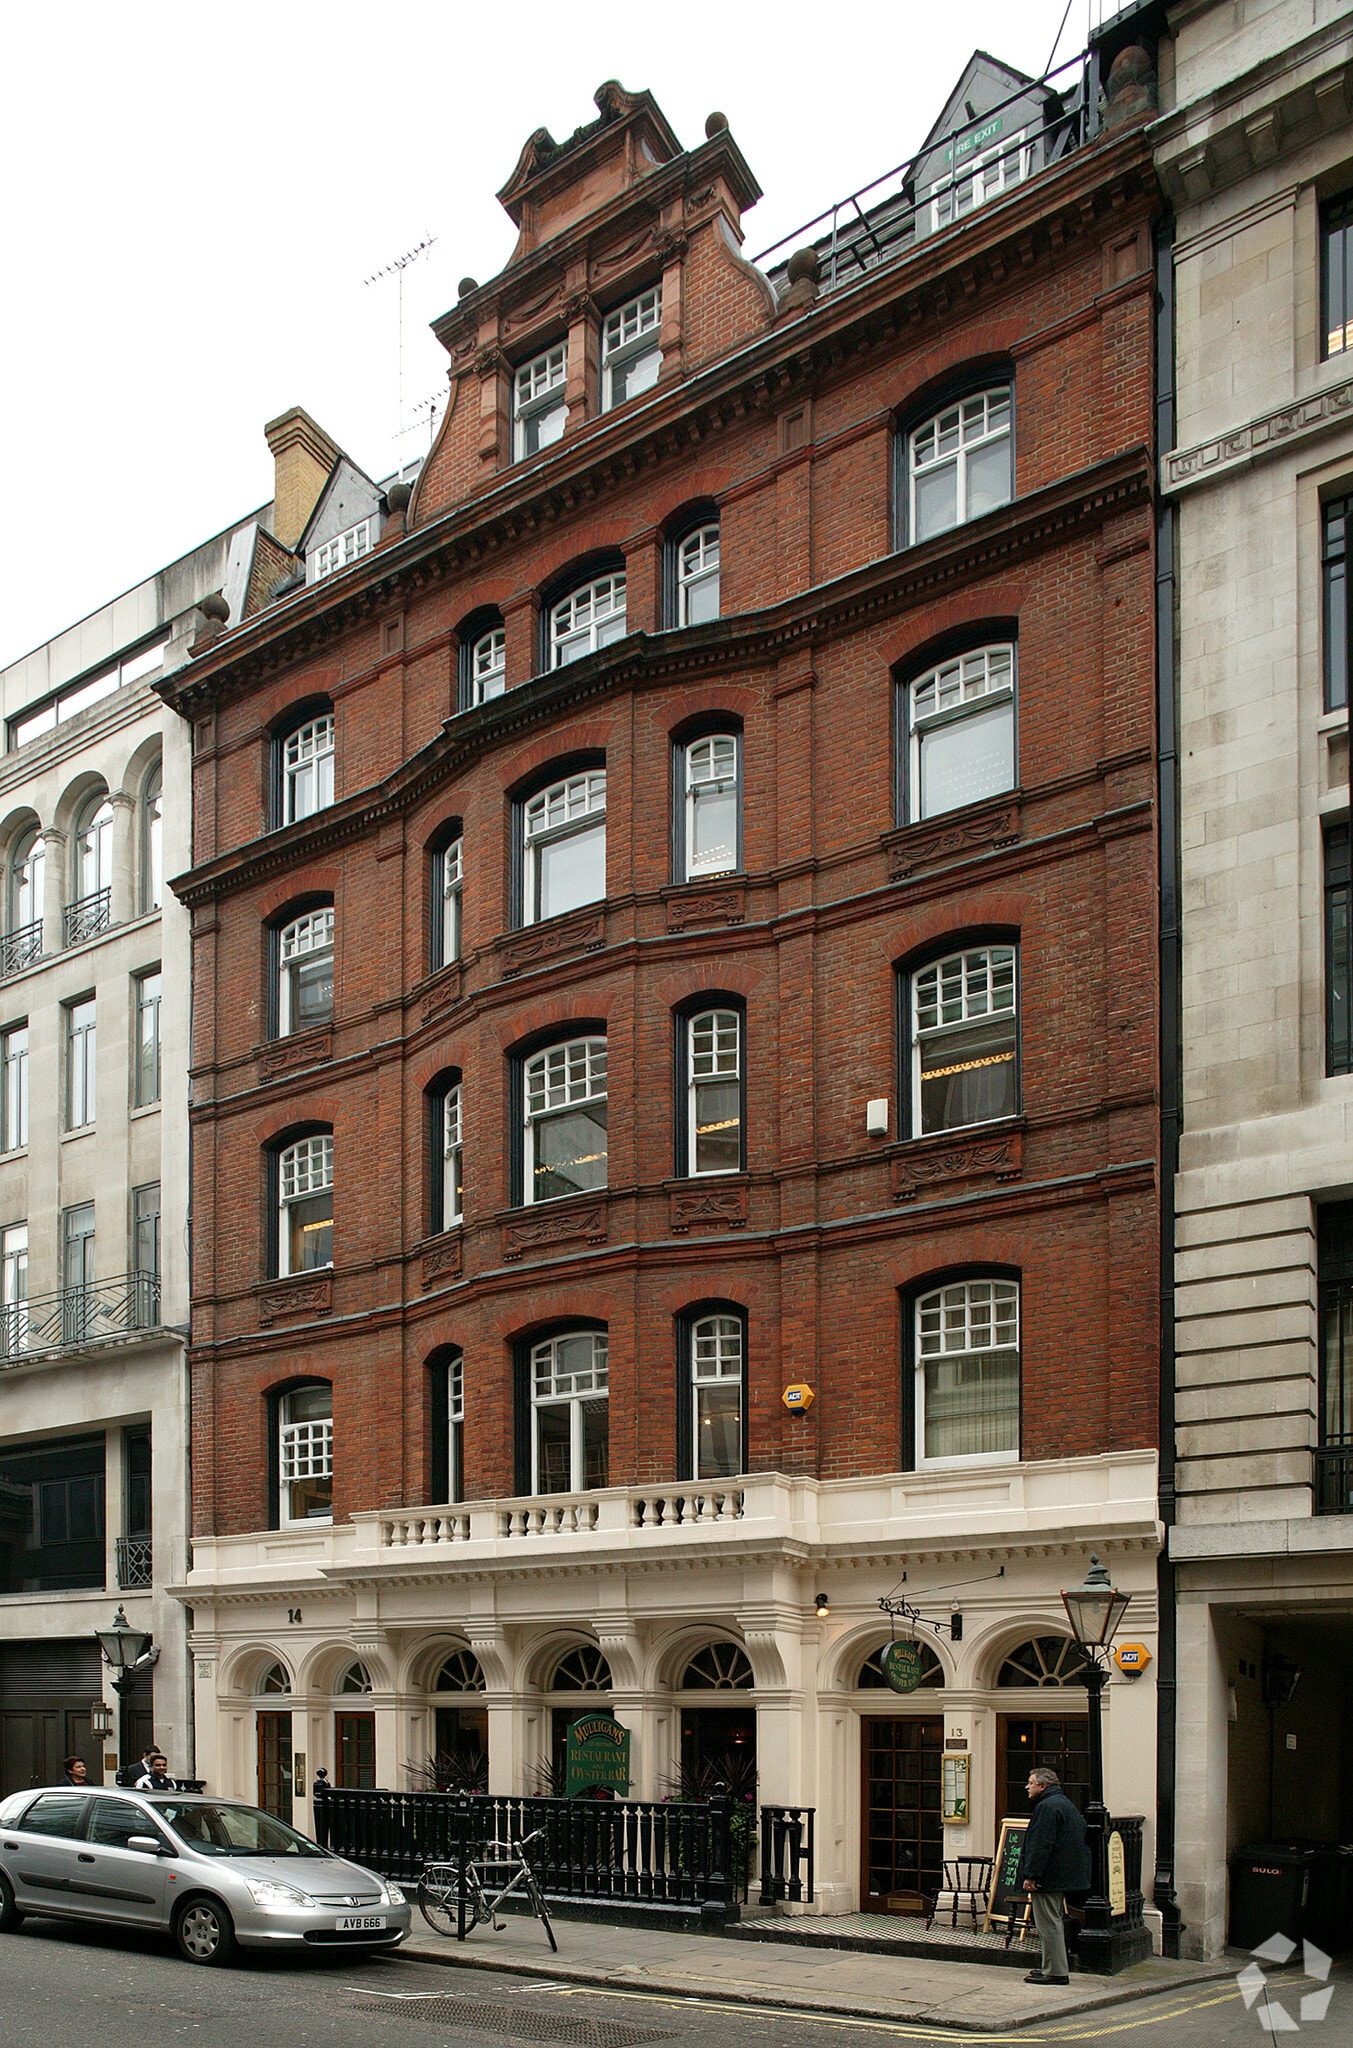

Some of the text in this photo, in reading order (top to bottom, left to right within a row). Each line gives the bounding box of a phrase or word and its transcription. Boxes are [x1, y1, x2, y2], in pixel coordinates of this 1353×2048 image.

[949, 122, 999, 160] FRE EXIT
[787, 1392, 801, 1400] ADT
[287, 1608, 302, 1623] 14
[1121, 1653, 1139, 1661] ADT
[573, 1721, 625, 1746] MULLIGANS
[951, 1728, 963, 1737] 13
[571, 1749, 627, 1763] RESTAURANT
[571, 1766, 626, 1780] OYSTER BAR
[1252, 1866, 1279, 1875] SULO
[343, 1917, 381, 1929] AVB 666
